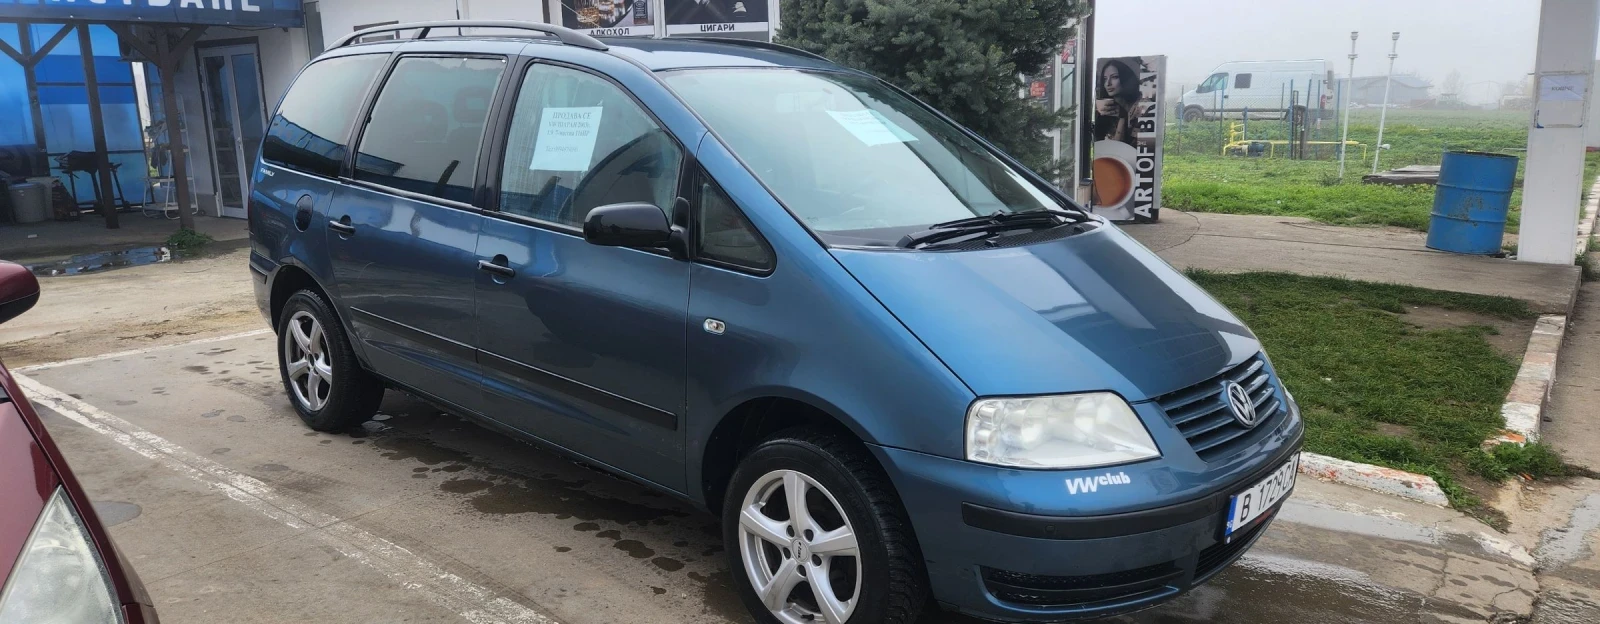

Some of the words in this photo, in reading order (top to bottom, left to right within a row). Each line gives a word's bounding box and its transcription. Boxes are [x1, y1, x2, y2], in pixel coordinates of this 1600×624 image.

[590, 27, 630, 36] АЛКОХОЛ
[700, 24, 735, 32] ЦИГАРИ
[1240, 494, 1251, 523] B
